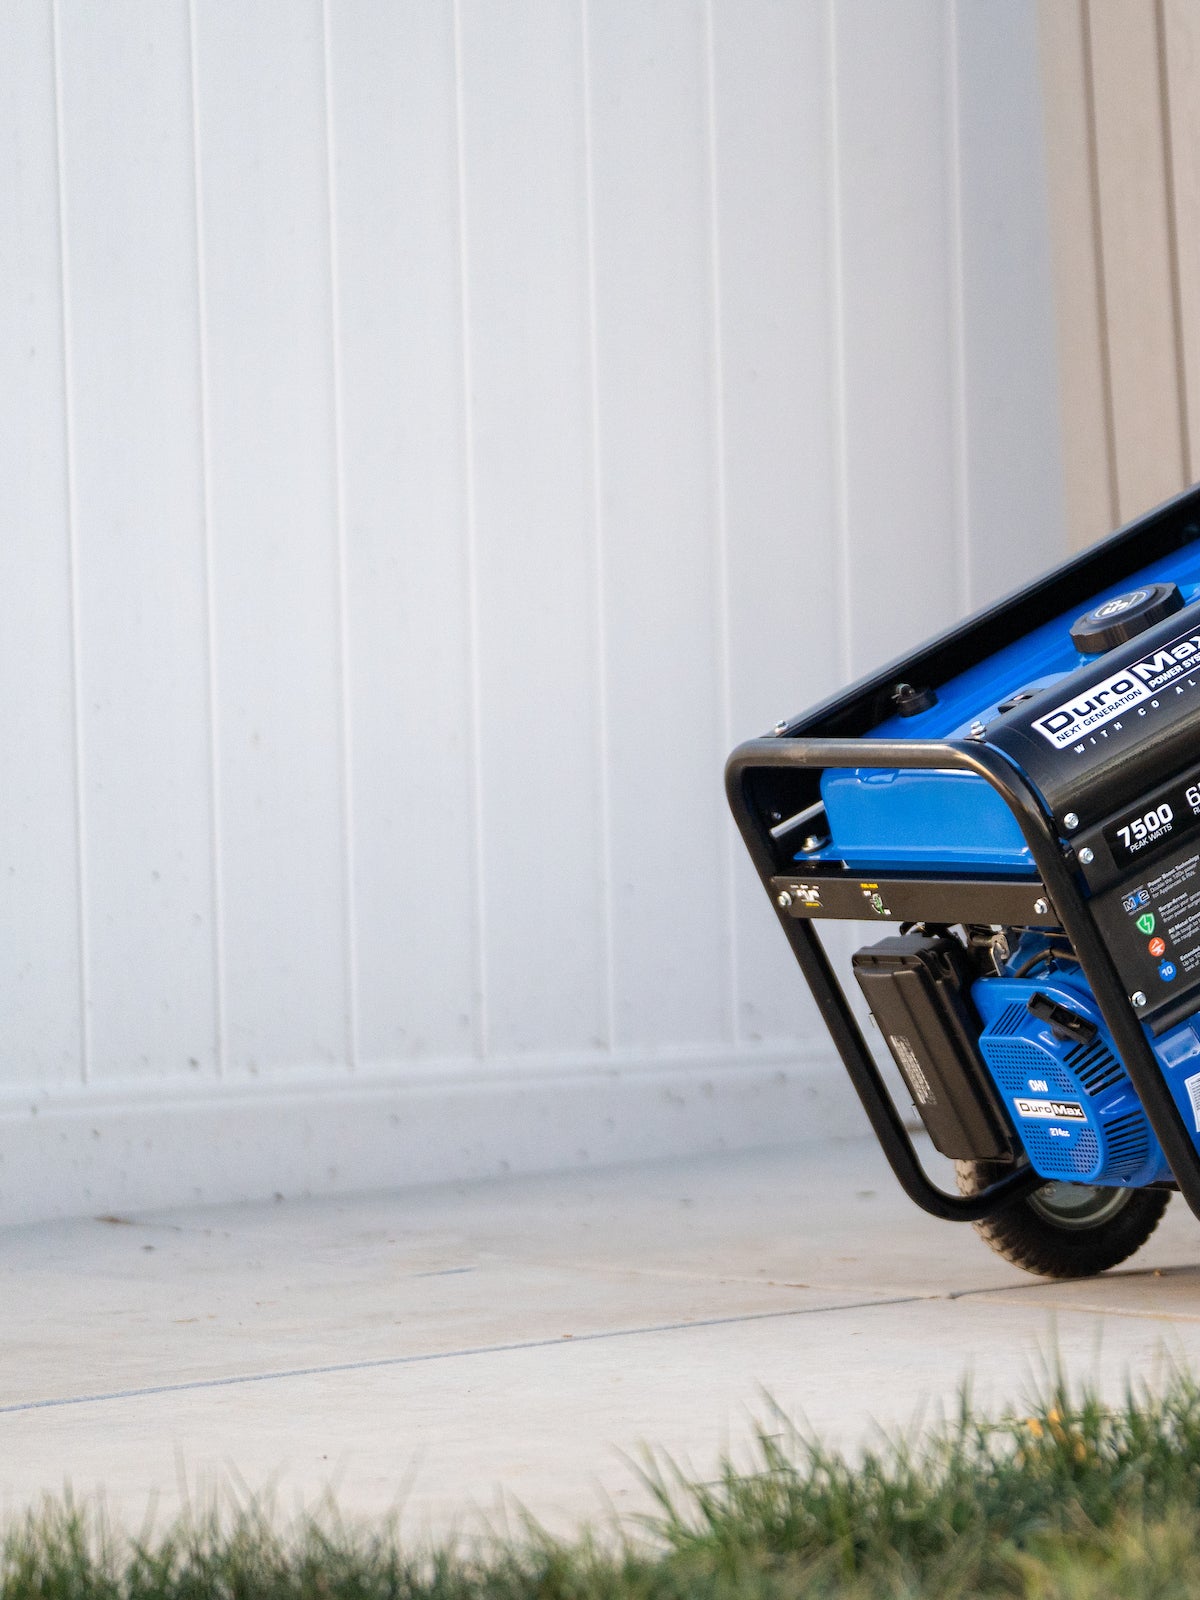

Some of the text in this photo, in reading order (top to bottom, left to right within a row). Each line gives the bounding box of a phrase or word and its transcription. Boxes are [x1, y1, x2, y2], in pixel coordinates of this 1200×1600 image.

[1148, 664, 1183, 689] POWER
[1056, 688, 1143, 743] NEXT GENERATION
[1074, 722, 1123, 754] WITH
[1138, 700, 1160, 717] CO
[1117, 803, 1174, 848] 7500
[1130, 823, 1173, 854] PEAK WATTS
[1161, 964, 1173, 977] 10
[1028, 1080, 1048, 1092] OHV
